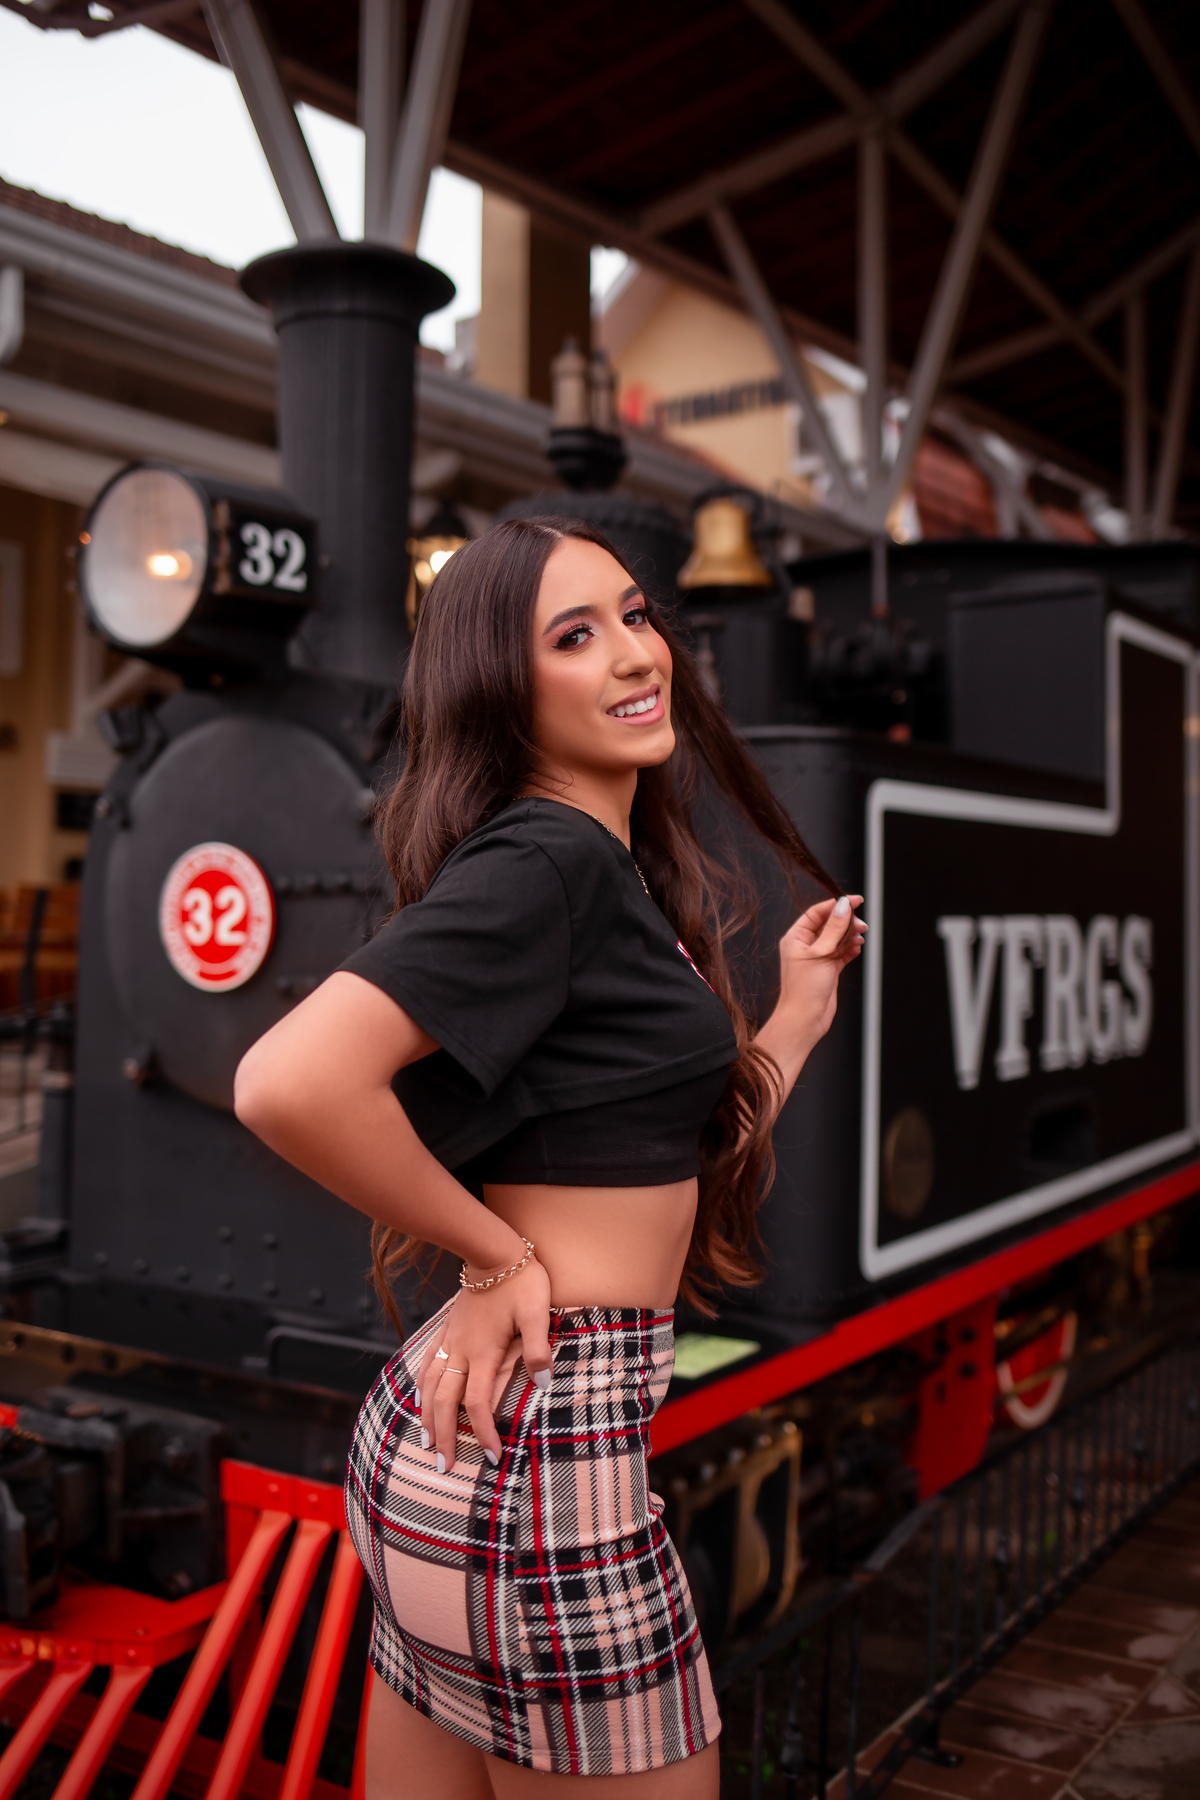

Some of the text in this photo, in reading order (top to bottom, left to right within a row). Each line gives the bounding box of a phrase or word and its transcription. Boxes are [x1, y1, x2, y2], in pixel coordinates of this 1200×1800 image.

[239, 522, 307, 592] 32
[183, 885, 248, 946] 32
[936, 913, 1153, 1090] VFRGS
